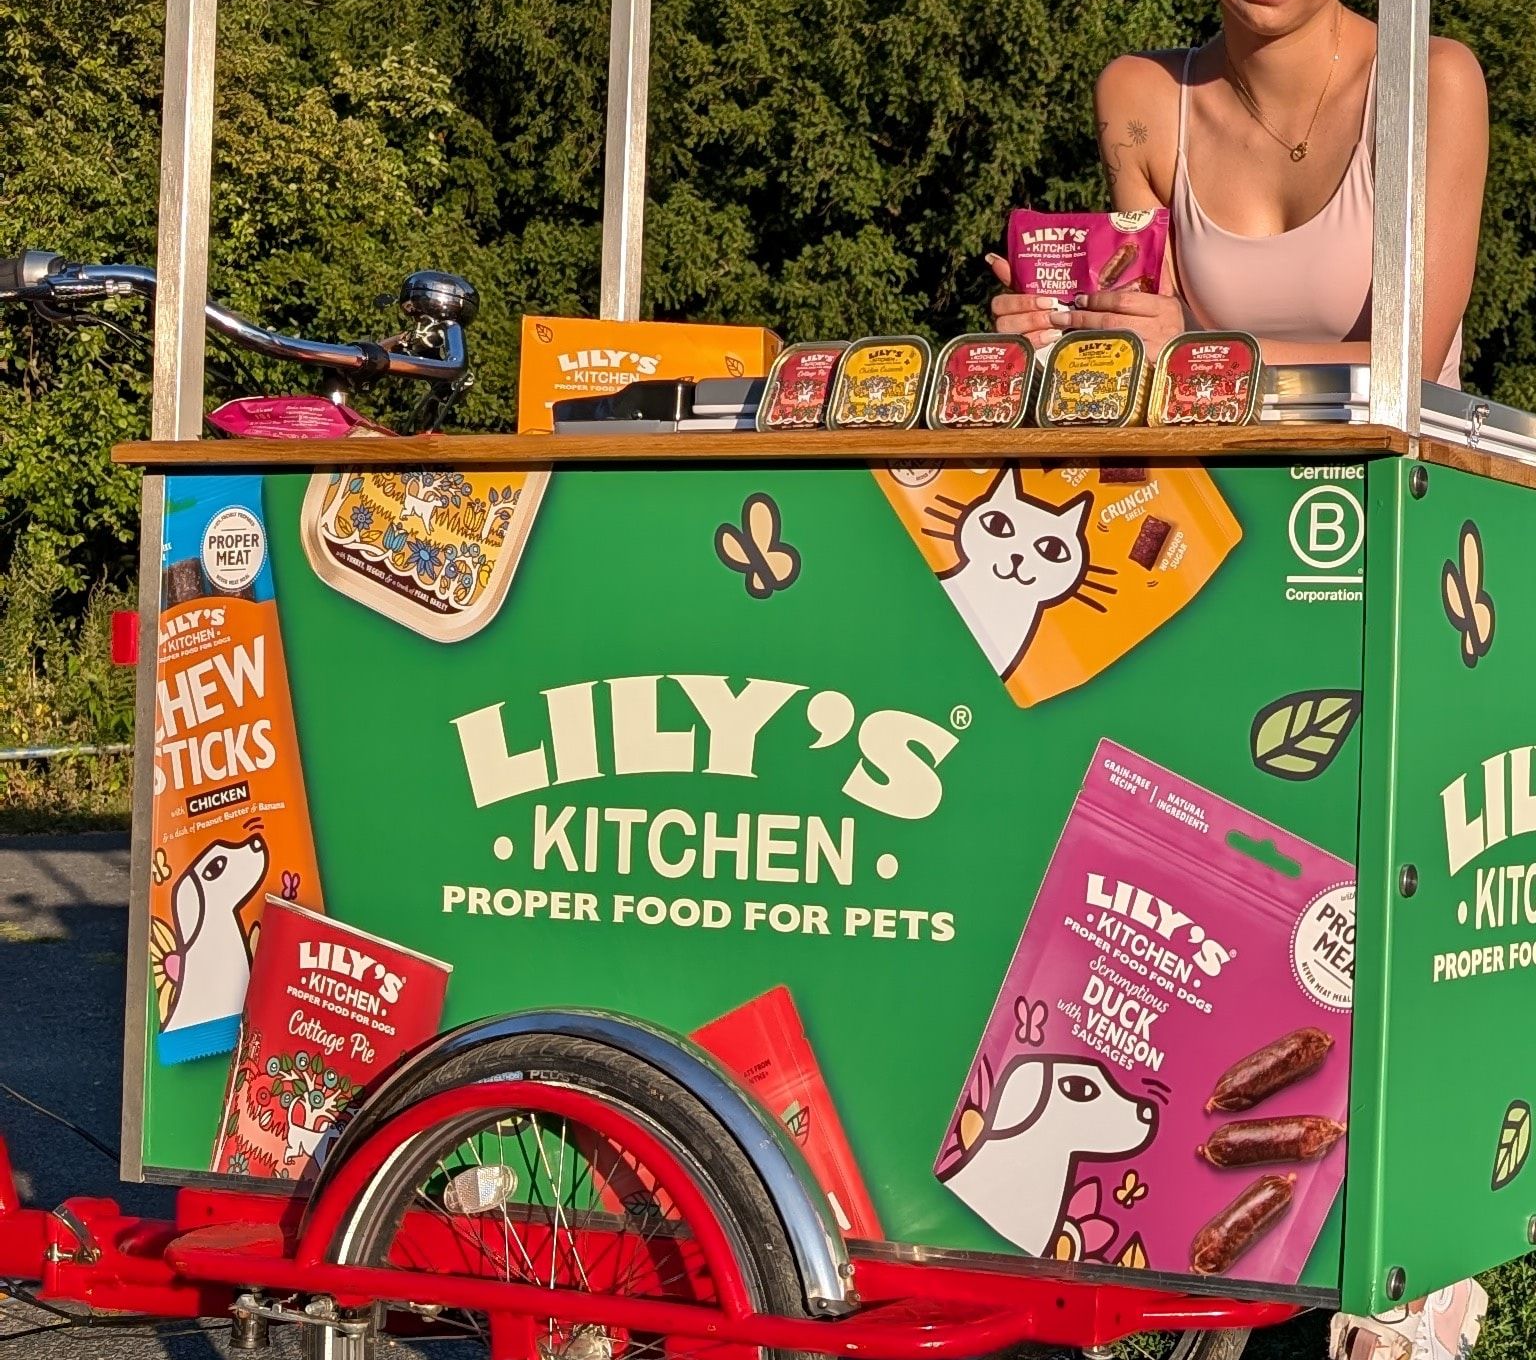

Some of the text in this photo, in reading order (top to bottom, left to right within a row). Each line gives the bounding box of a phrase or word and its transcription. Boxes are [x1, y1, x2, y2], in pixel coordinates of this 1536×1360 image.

[1022, 227, 1088, 245] LILY'S
[1032, 243, 1076, 253] KITCHEN
[1036, 268, 1071, 281] DUCK
[1040, 280, 1077, 290] VENISON
[554, 383, 588, 392] PROPER
[590, 385, 615, 393] FOOD
[574, 370, 640, 385] KITCHEN
[1100, 480, 1160, 523] CRUNCHY
[1125, 506, 1147, 522] SHELL
[208, 533, 260, 550] PROPER
[1310, 502, 1345, 552] B
[216, 550, 251, 567] MEAT
[1169, 542, 1188, 570] SUGAR
[1286, 588, 1363, 603] Corporation
[167, 628, 215, 653] KITCHEN
[157, 635, 264, 744] HEW
[1103, 758, 1150, 790] GRAIN-FREE
[1109, 773, 1138, 795] RECIPE
[189, 785, 247, 813] CHICKEN
[197, 814, 223, 831] Peanut
[224, 806, 249, 821] Butter
[258, 801, 286, 812] Banana
[1157, 799, 1209, 834] INGREDIENTS
[1167, 792, 1206, 821] NATURAL
[533, 804, 855, 886] KITCHEN
[442, 885, 956, 942] PROPER FOOD FOR PETS
[1064, 916, 1213, 1014] PROPER FOOD FOR DOGS
[1096, 911, 1193, 984] KITCHEN
[1432, 944, 1505, 983] PROPER
[299, 941, 403, 1004] LILY'S
[1089, 955, 1170, 1013] Scrumptious
[1302, 961, 1316, 985] NEVER
[1314, 982, 1331, 998] MEAT
[287, 985, 396, 1036] PROPER FOOD FOR DOGS
[309, 971, 380, 1015] KITCHEN
[1082, 974, 1159, 1041] DUCK
[288, 1009, 375, 1064] Cottage Pie
[1056, 998, 1165, 1072] with VENISON
[1071, 1023, 1135, 1071] SAUSAGES
